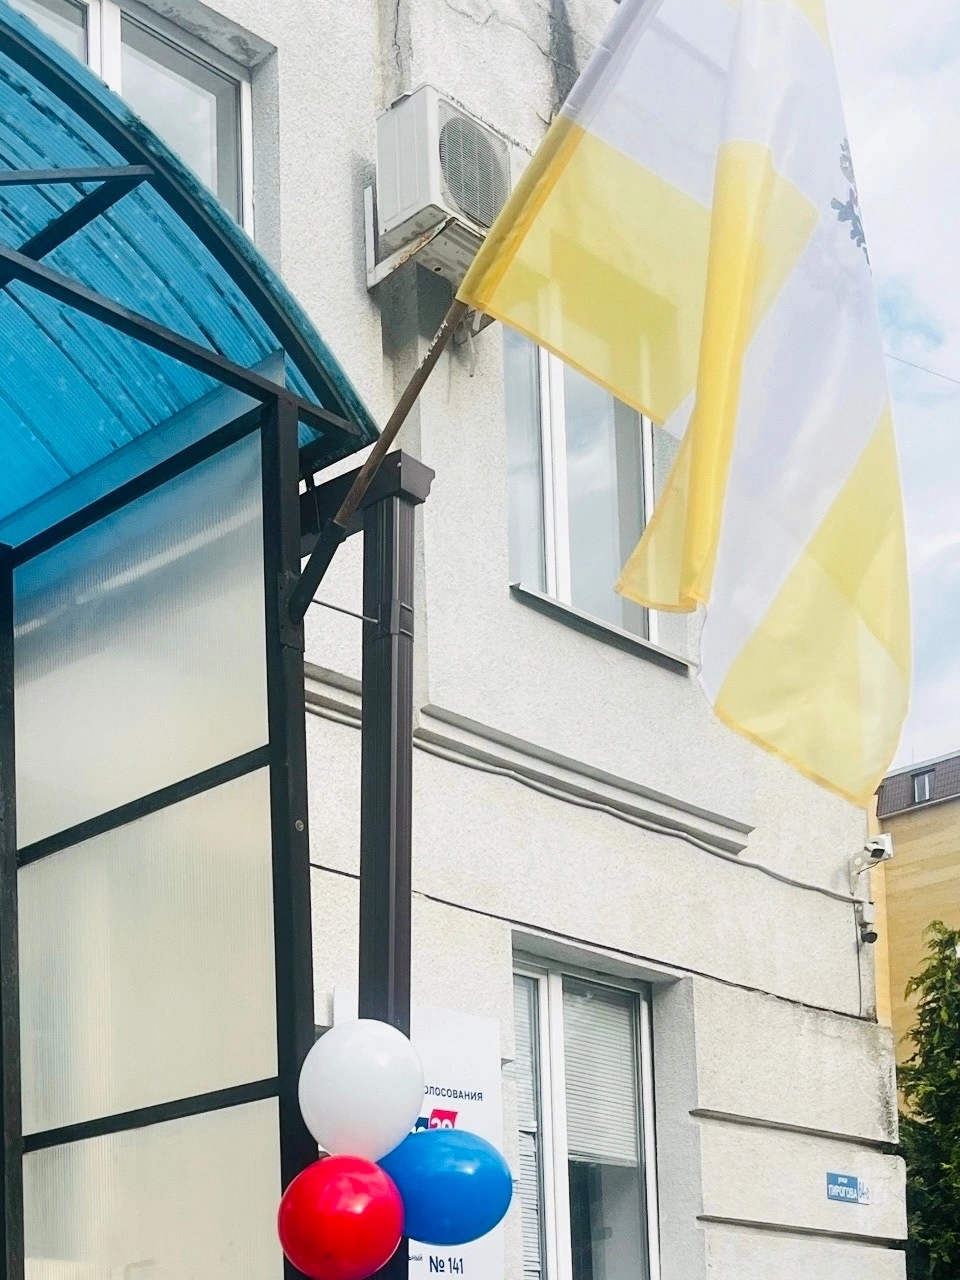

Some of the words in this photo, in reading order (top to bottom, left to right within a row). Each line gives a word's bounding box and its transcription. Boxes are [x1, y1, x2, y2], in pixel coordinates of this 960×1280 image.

[424, 1085, 483, 1101] ОЛОСОВАНИЯ
[828, 1184, 858, 1199] ПИРОГОВА
[429, 1255, 445, 1273] №
[448, 1257, 464, 1274] 141
